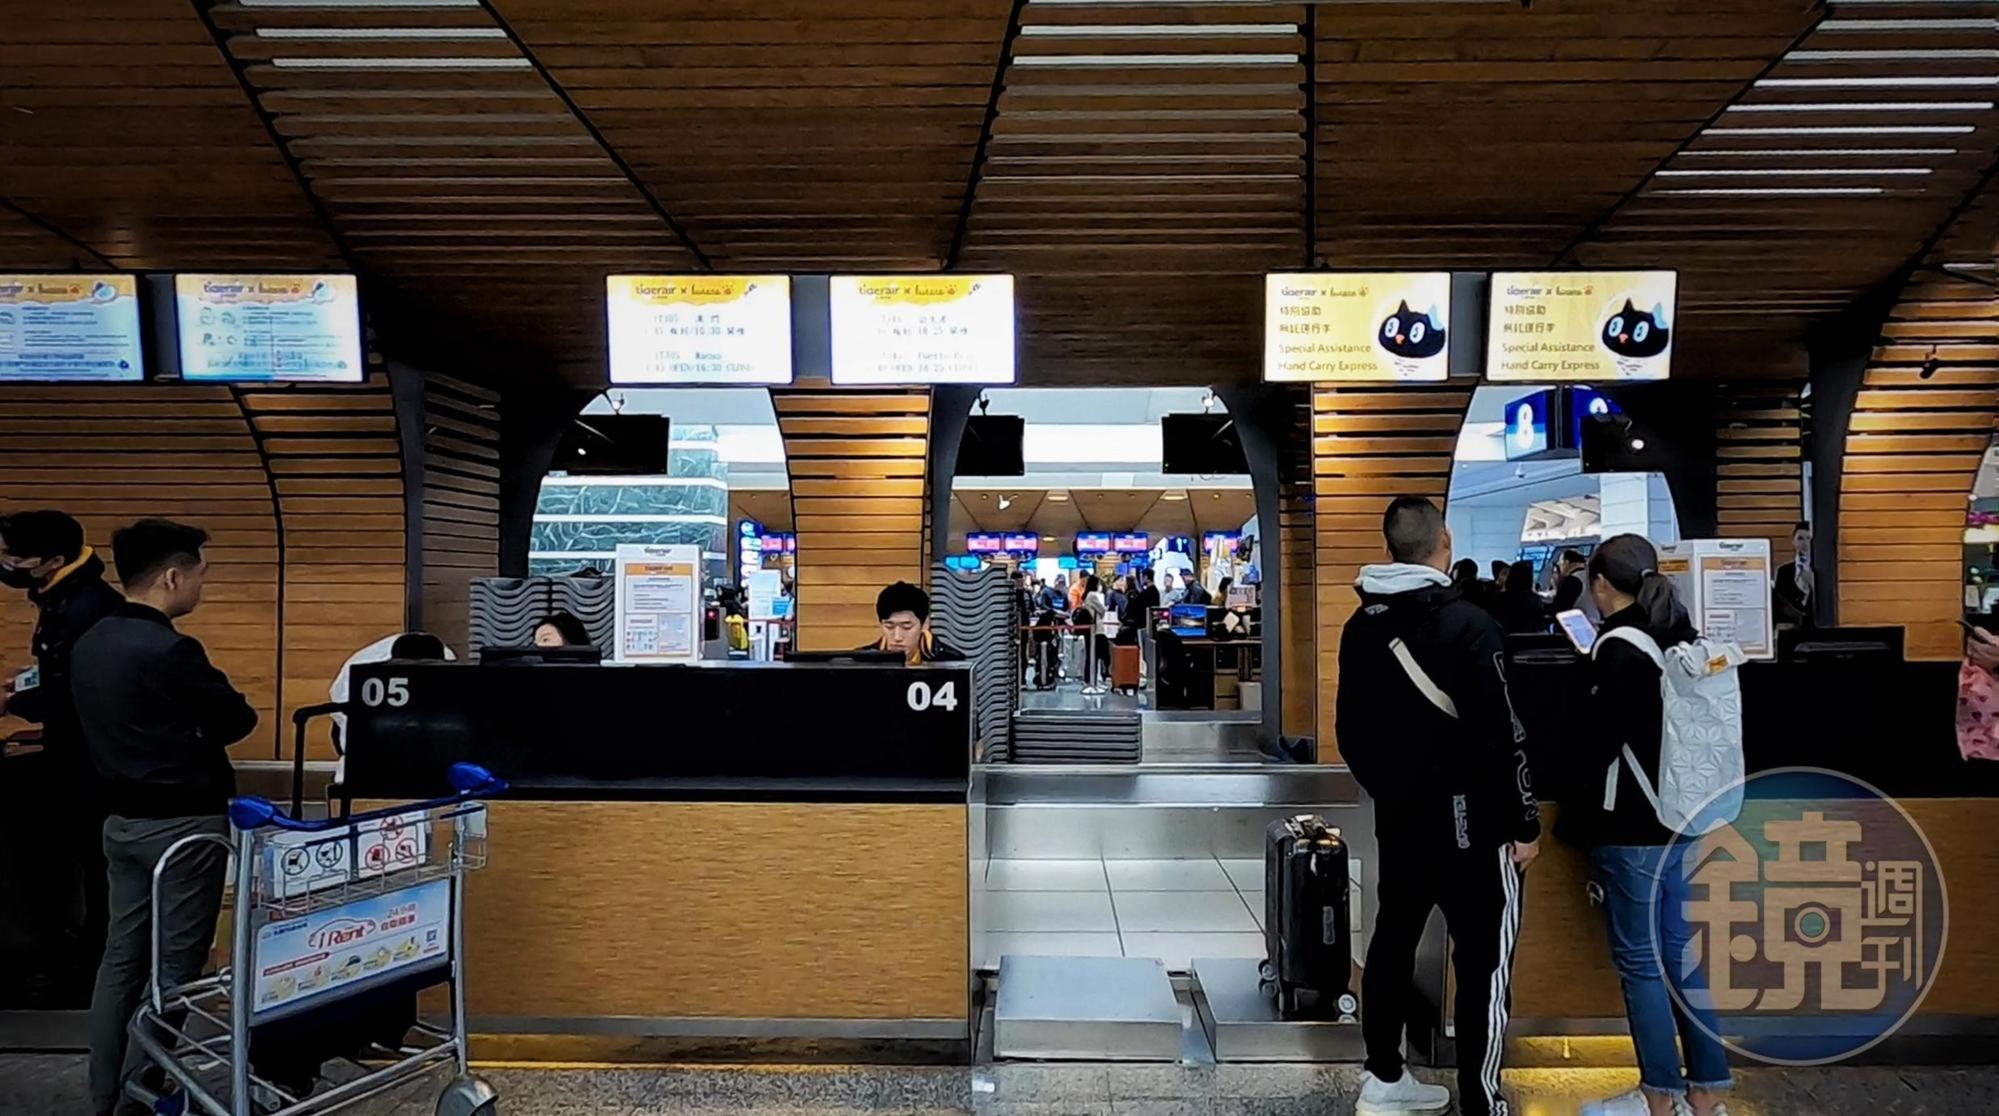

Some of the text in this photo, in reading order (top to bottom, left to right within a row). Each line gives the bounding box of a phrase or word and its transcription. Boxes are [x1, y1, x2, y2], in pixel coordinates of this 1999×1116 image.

[1279, 343, 1372, 354] Special Assistance
[1502, 343, 1596, 354] Special Assistance
[1278, 361, 1378, 373] Hand Carry Express
[1501, 361, 1600, 372] Hand Carry Express
[1517, 403, 1535, 450] 8
[362, 677, 410, 707] 05
[906, 681, 959, 712] 04
